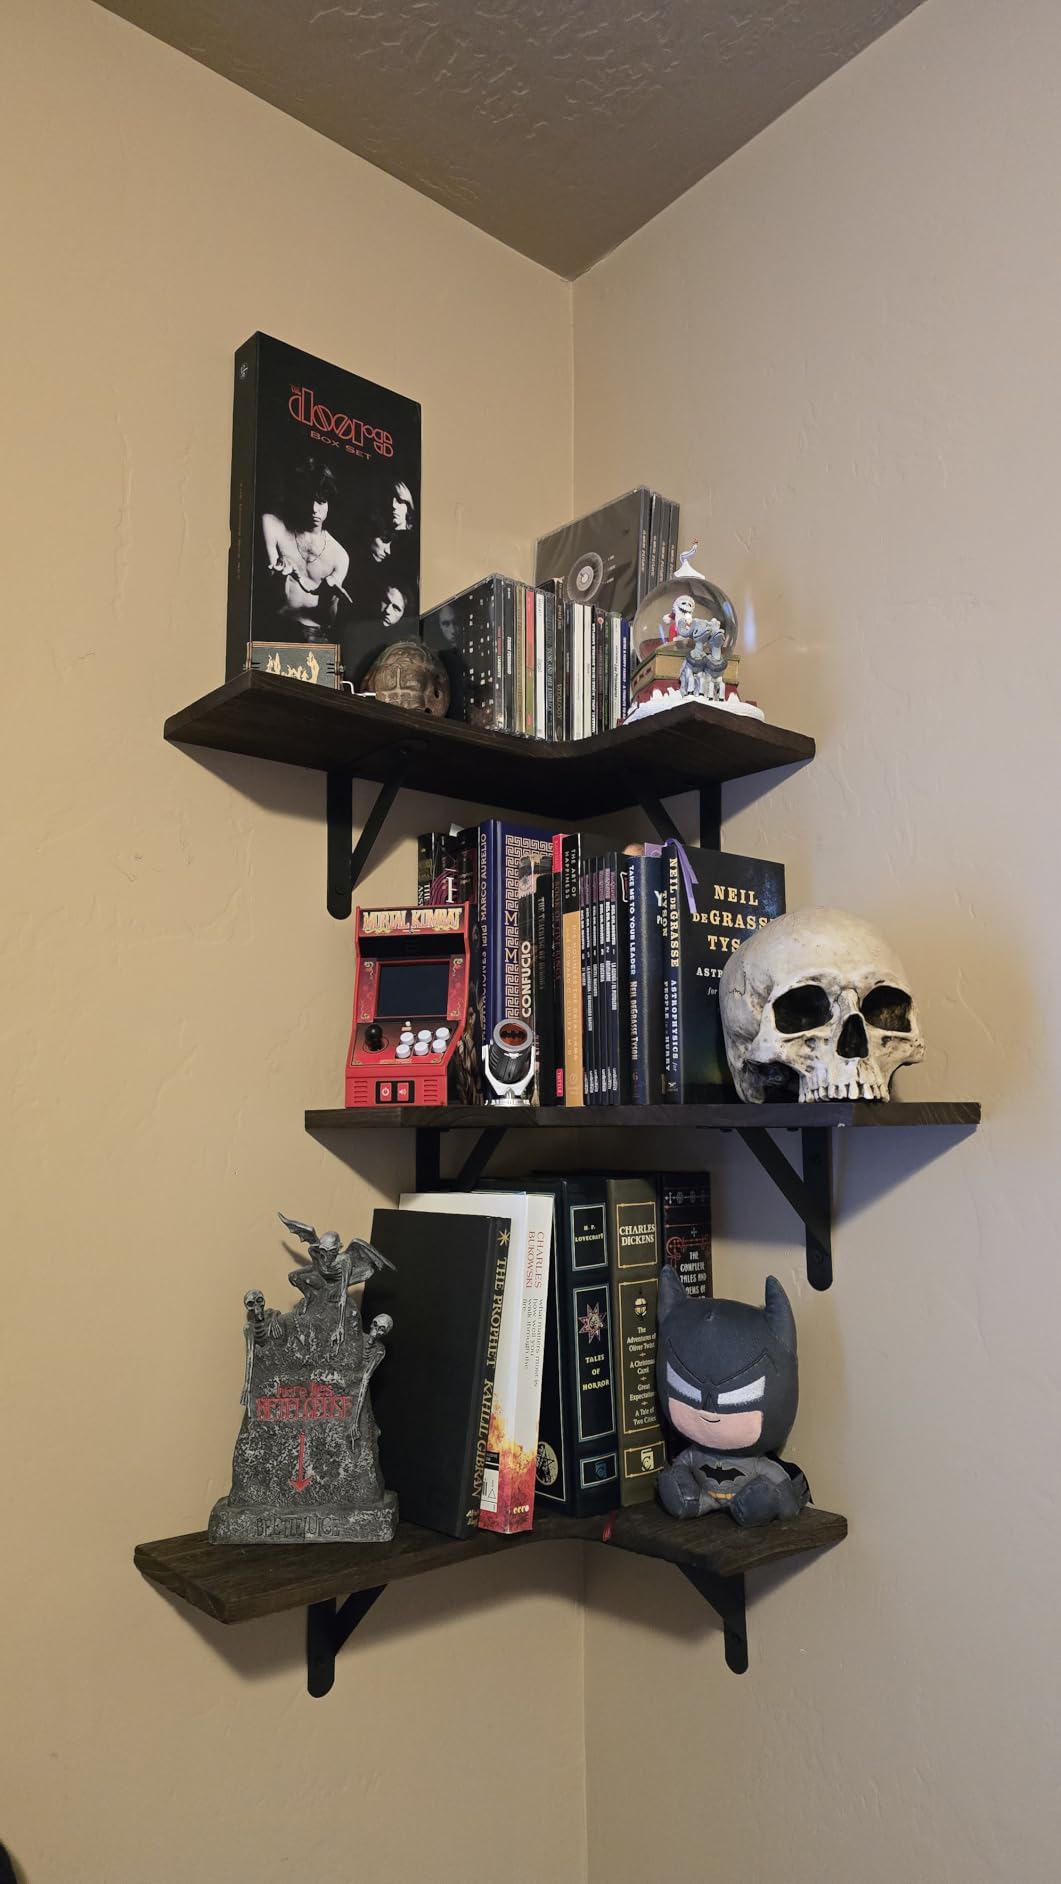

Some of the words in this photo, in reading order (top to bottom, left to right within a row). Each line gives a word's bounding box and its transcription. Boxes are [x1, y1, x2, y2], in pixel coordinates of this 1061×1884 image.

[310, 430, 340, 448] BOX
[345, 445, 372, 461] SET
[670, 858, 678, 893] NEIL
[572, 886, 576, 897] OF
[629, 888, 634, 900] ME
[714, 885, 758, 906] NEIL
[630, 902, 635, 914] TO
[362, 910, 410, 931] MORTAL
[411, 907, 462, 930] KOMBAT
[692, 910, 773, 930] DEGRASS
[707, 935, 740, 952] TYS
[521, 941, 532, 1018] CONFUCIO
[575, 1233, 604, 1242] LOVECRAFT
[619, 1224, 656, 1236] CHARLES
[621, 1234, 654, 1246] DICKENS
[526, 1231, 535, 1288] BUKOWSKI
[534, 1231, 544, 1289] CHARLES
[690, 1252, 699, 1260] THE
[494, 1257, 507, 1291] THE
[680, 1275, 696, 1284] TALES
[487, 1295, 503, 1369] PROPHET
[627, 1334, 651, 1344] Adventures
[629, 1344, 643, 1352] Oliver
[644, 1342, 655, 1350] Twist
[585, 1354, 604, 1364] TALES
[276, 1384, 307, 1398] here
[310, 1381, 334, 1397] lies
[582, 1380, 609, 1391] HORROR
[478, 1378, 494, 1438] KAHLIL
[640, 1408, 649, 1416] Tale
[471, 1440, 486, 1498] GIBRAN
